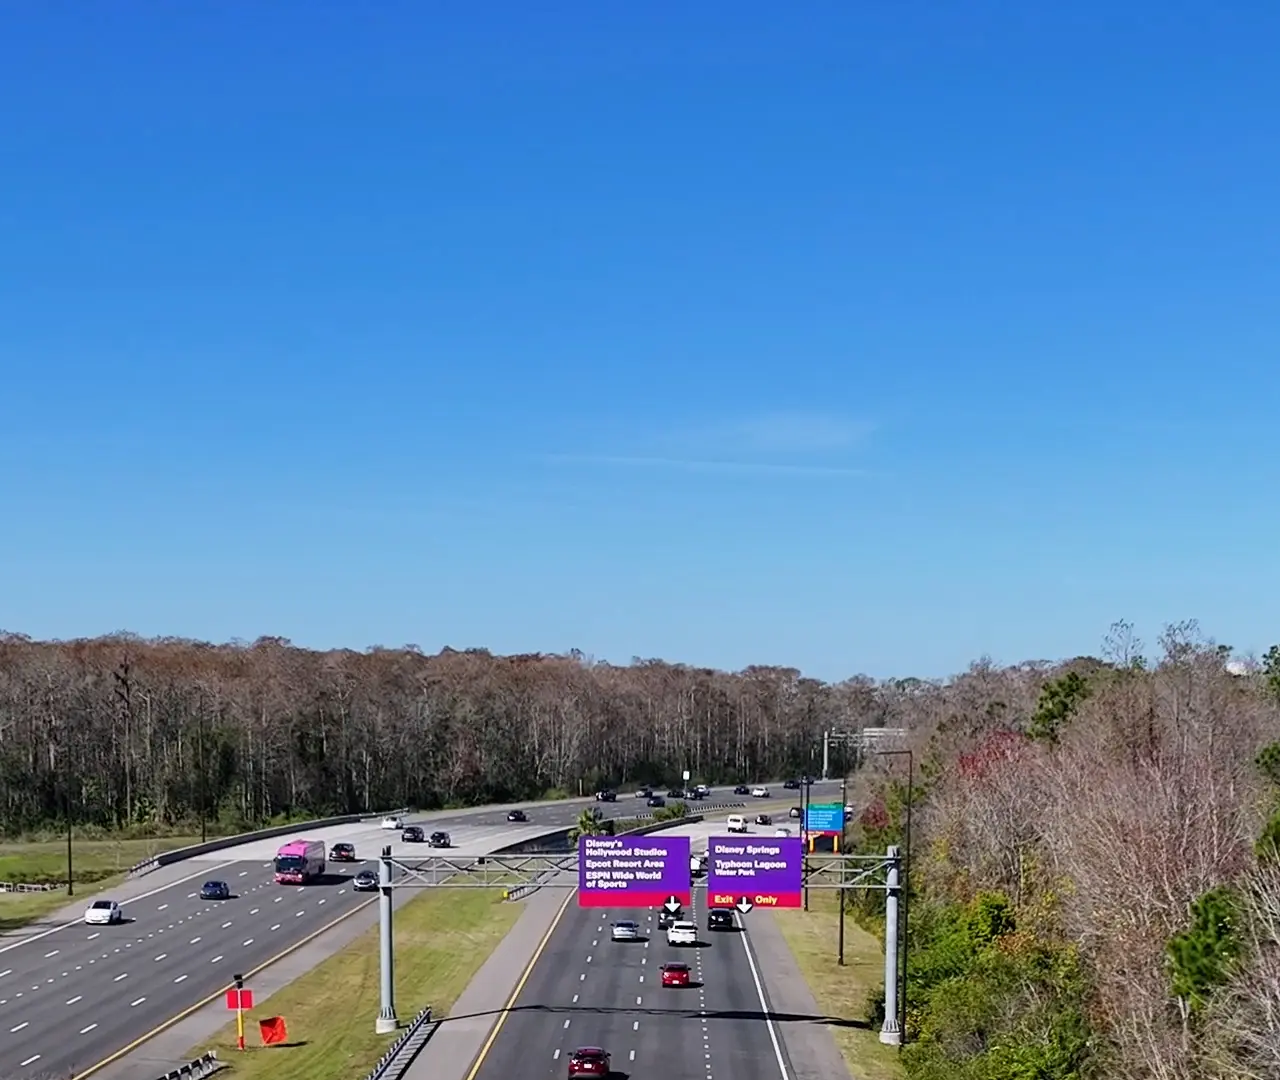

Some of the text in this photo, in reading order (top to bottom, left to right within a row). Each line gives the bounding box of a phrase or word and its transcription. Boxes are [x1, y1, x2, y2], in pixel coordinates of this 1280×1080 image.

[585, 840, 623, 848] Disney's
[585, 848, 668, 857] Hollywood Studios
[714, 845, 780, 855] Disney Springs
[585, 859, 665, 869] Epcot Resort Area
[715, 860, 787, 870] Typhoon Lagoon
[585, 871, 662, 880] ESPN Wide World
[585, 880, 627, 889] of Sports
[714, 895, 778, 905] Exit Only
